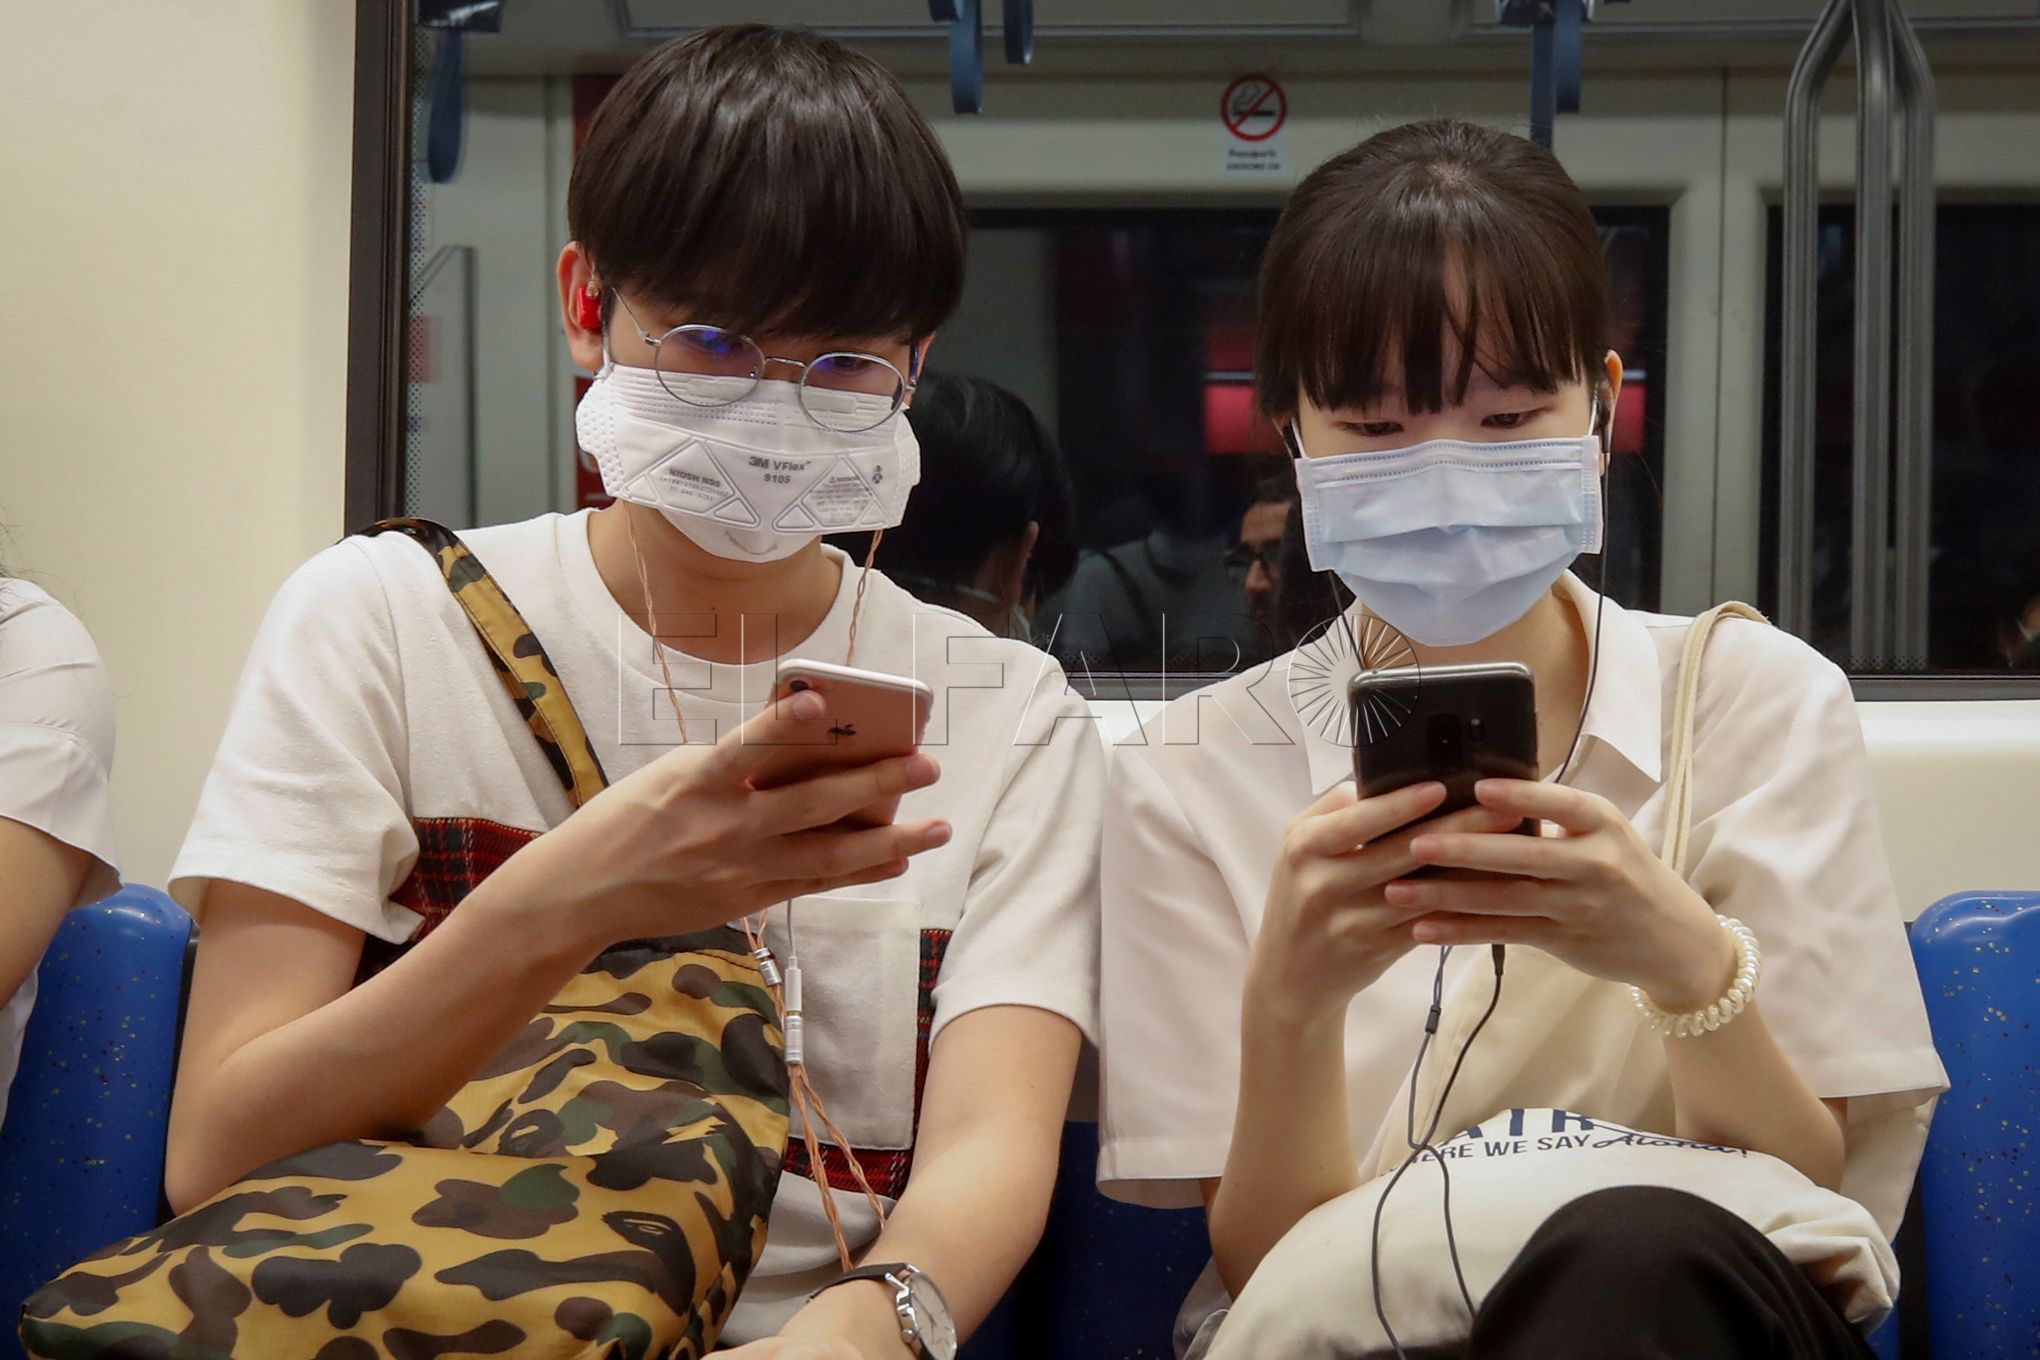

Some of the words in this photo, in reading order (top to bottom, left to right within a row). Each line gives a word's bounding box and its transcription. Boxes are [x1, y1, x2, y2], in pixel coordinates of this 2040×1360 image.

[749, 456, 769, 469] 3M
[764, 473, 792, 483] 9105
[1485, 1140, 1528, 1157] WE
[1537, 1134, 1591, 1151] SAY
